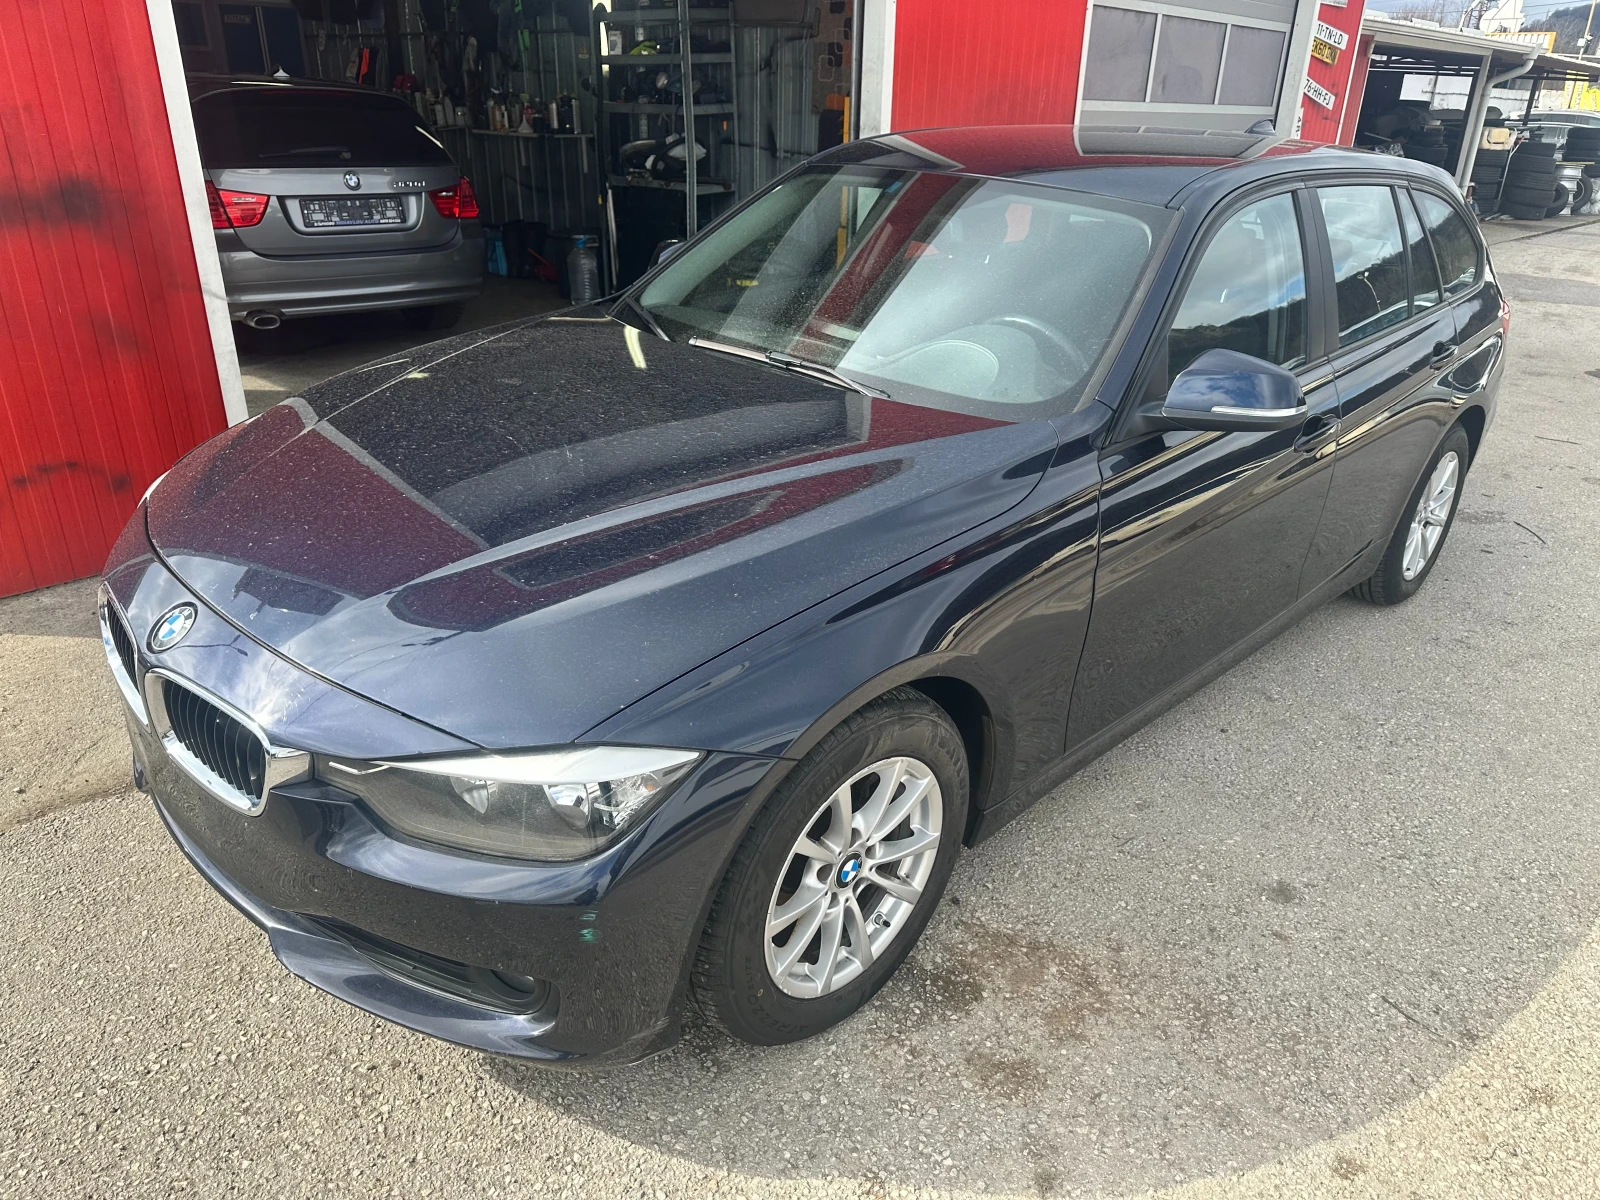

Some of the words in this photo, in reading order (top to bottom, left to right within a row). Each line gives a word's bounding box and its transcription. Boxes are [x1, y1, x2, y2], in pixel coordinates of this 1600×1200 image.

[1316, 23, 1343, 45] 11-TN-LD
[1303, 78, 1332, 106] 76-HH-FJ
[744, 956, 756, 990] ELITE
